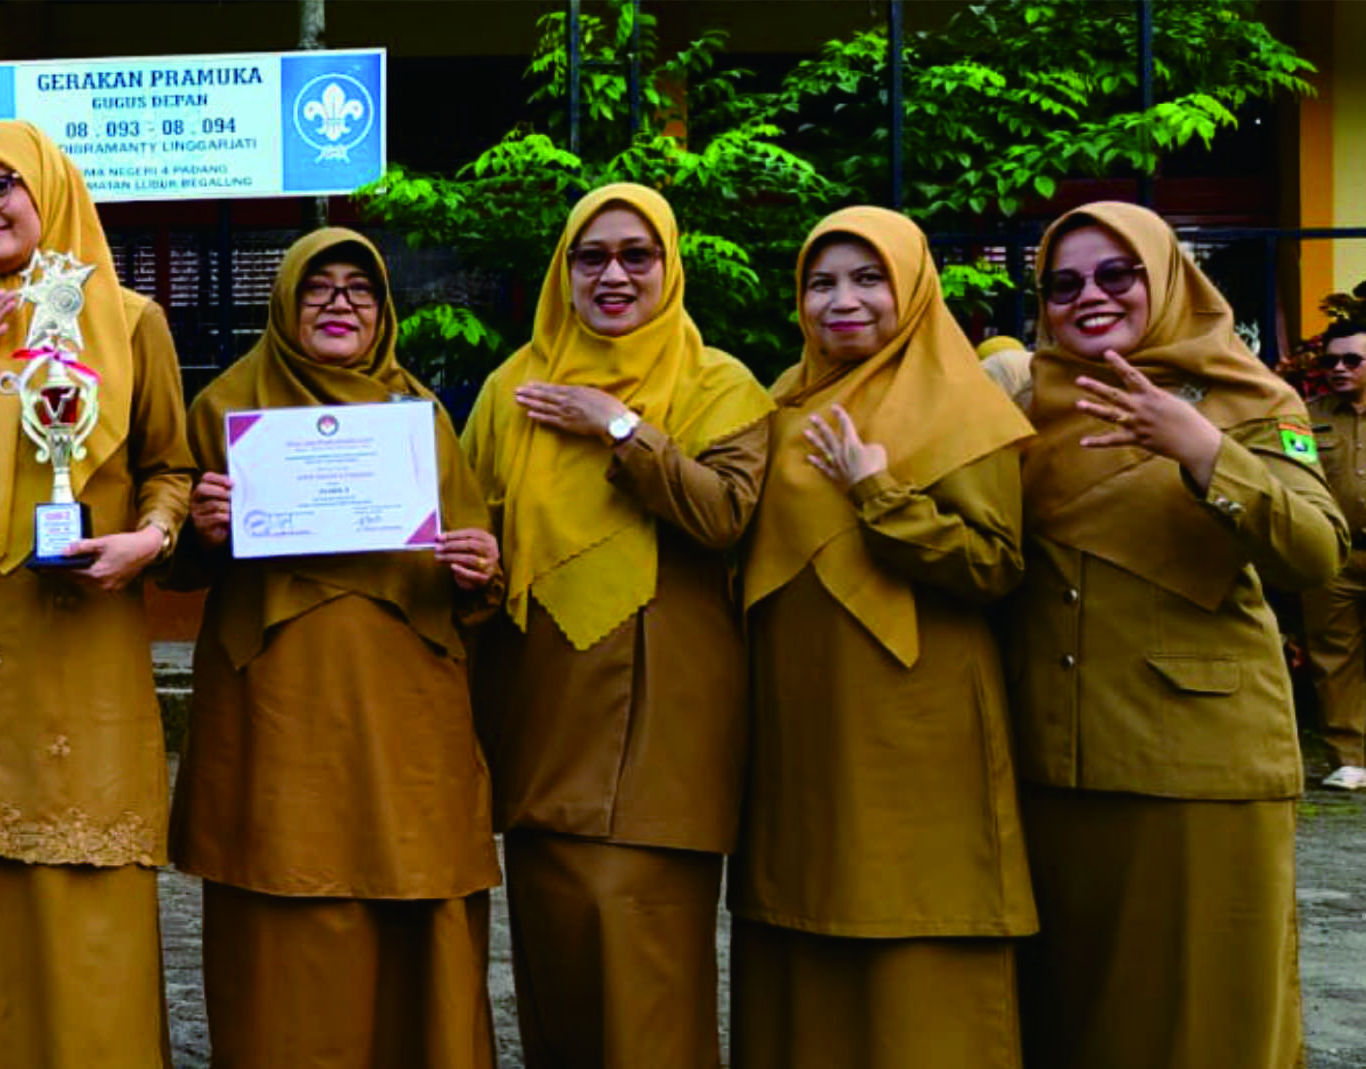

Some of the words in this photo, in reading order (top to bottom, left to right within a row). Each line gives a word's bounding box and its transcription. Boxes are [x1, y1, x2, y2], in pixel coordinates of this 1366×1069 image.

[37, 71, 143, 91] GERAKAN
[150, 67, 263, 87] PRAMUKA
[92, 96, 147, 110] GUGUS
[152, 94, 208, 108] DEPAN
[65, 122, 88, 138] 08
[106, 121, 140, 137] 093
[162, 119, 184, 136] 08
[202, 117, 236, 134] 094
